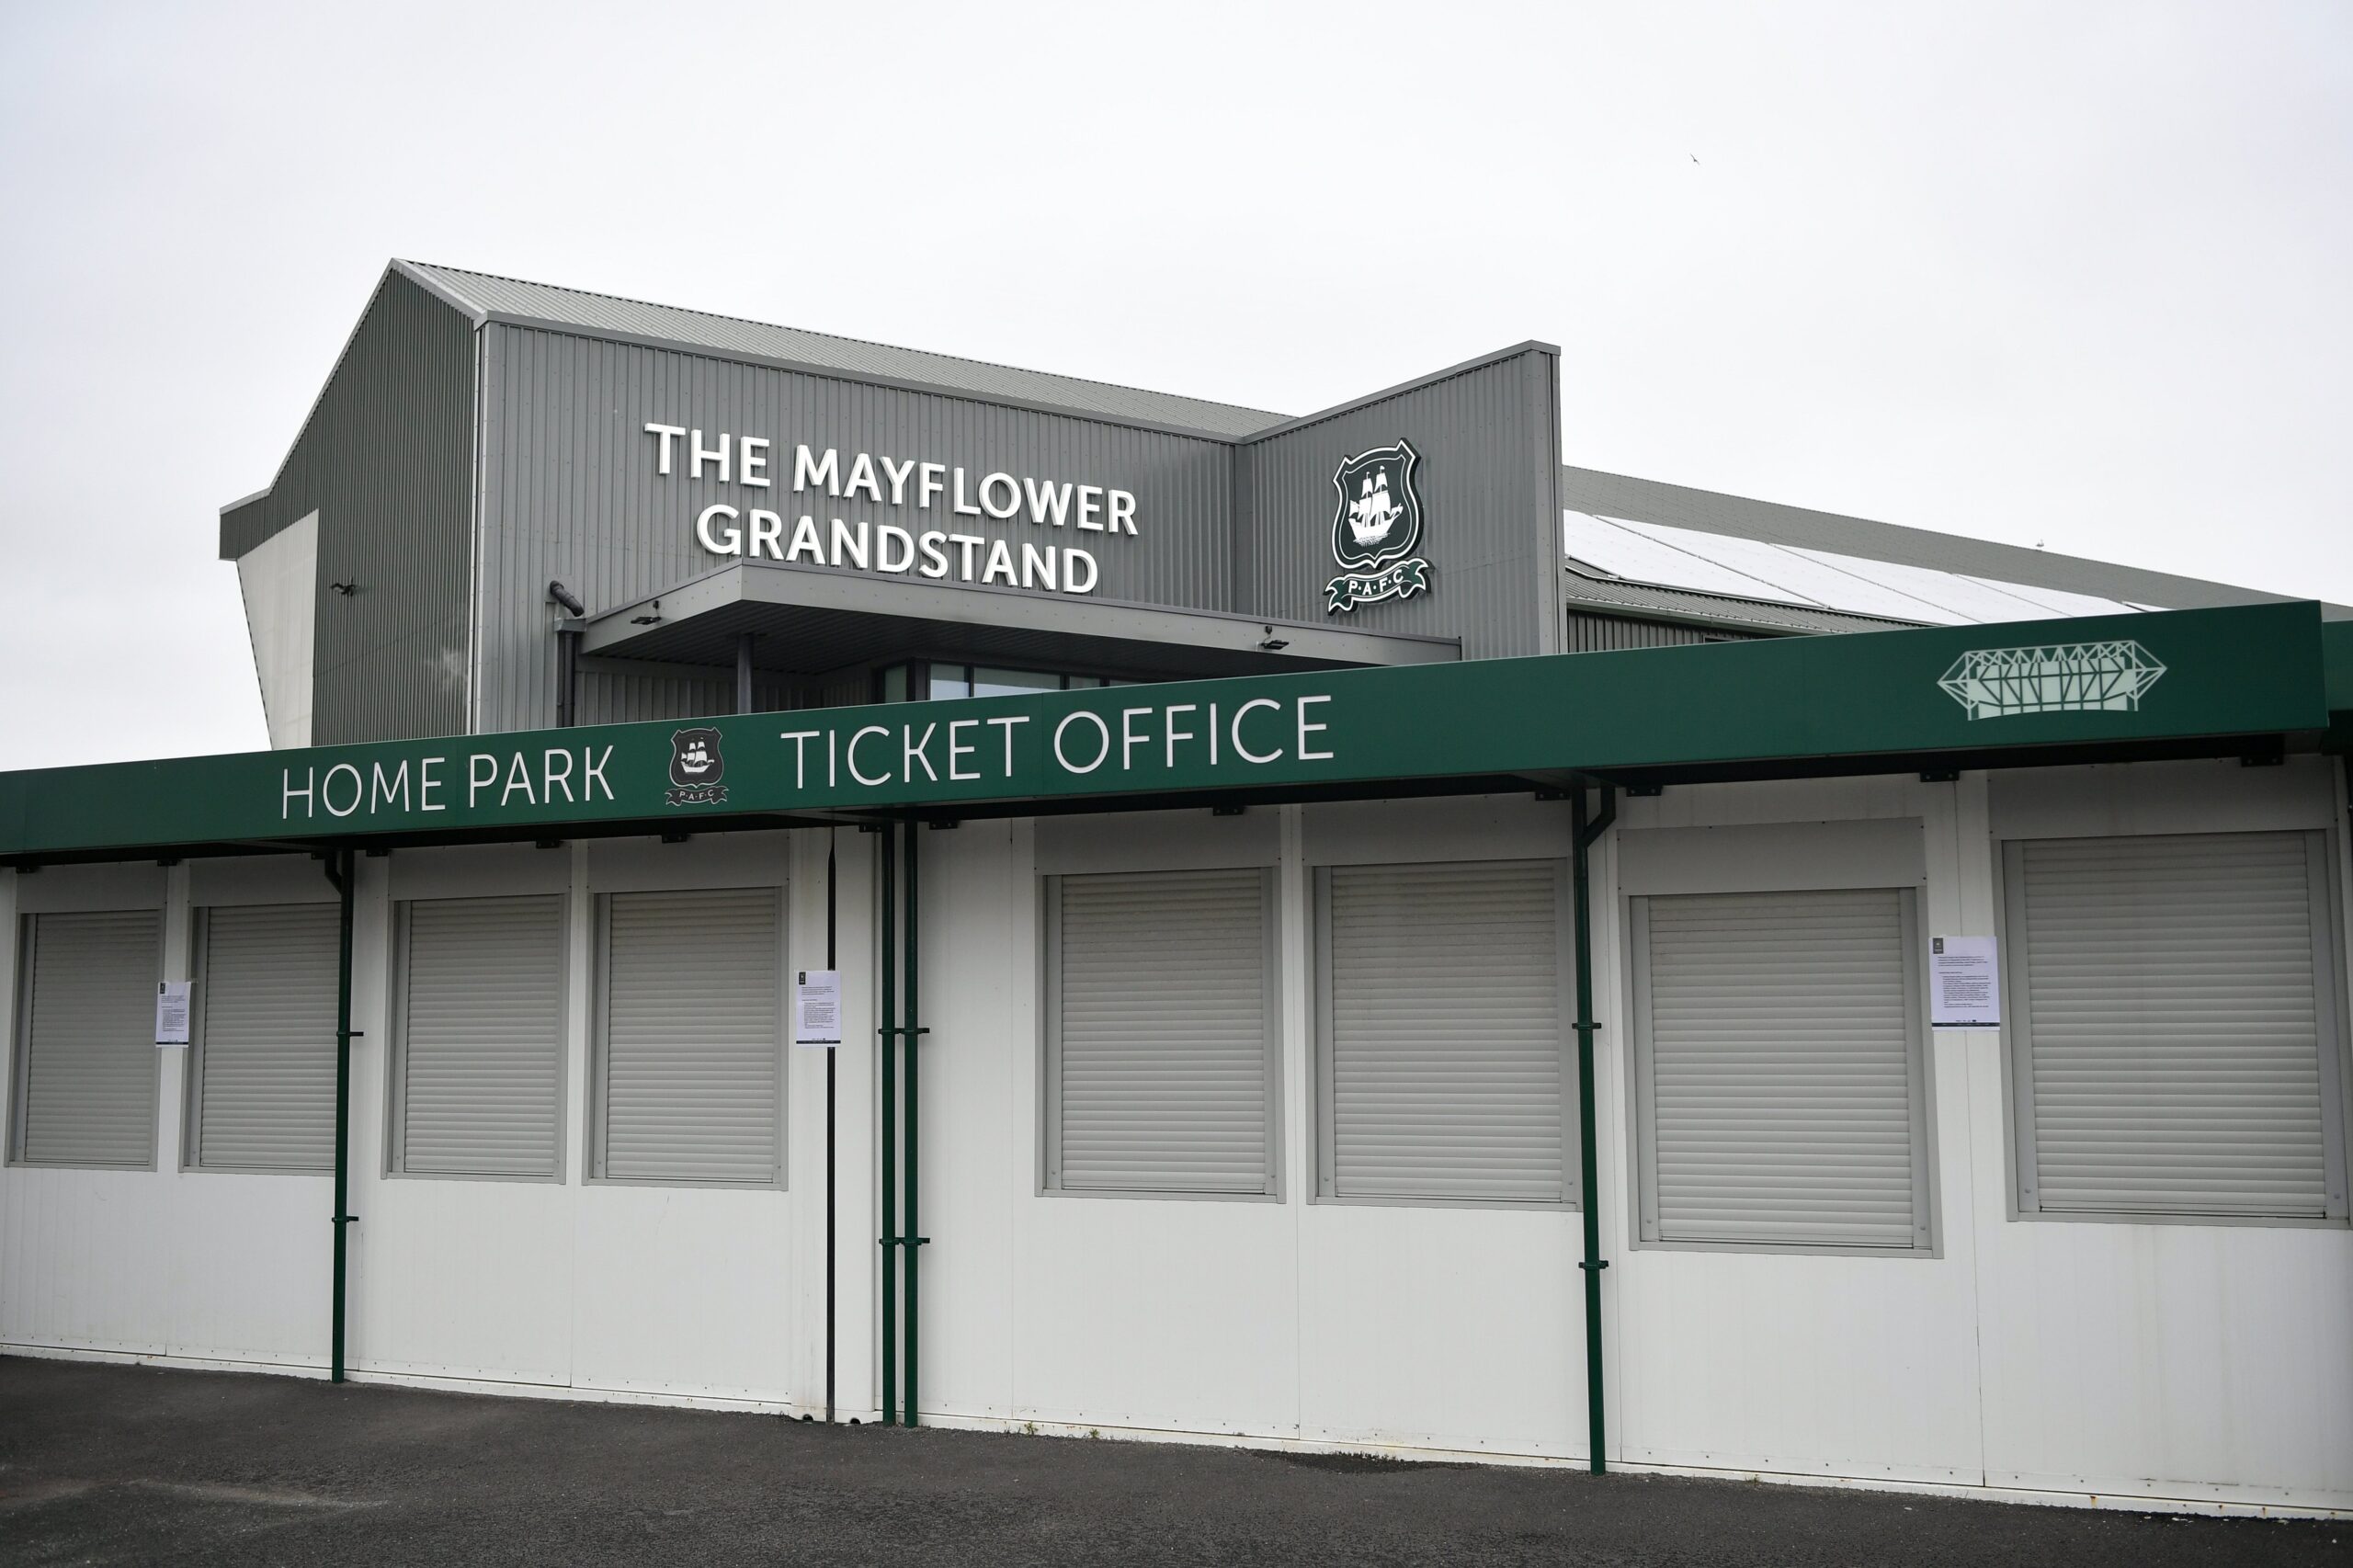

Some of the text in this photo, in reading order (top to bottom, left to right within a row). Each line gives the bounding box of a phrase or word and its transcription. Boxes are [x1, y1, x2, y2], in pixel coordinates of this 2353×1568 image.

[644, 423, 1139, 536] THE MAYFLOWER
[696, 504, 1099, 595] GRANDSTAND
[282, 745, 615, 819] HOME PARK
[780, 695, 1335, 790] TICKET OFFICE
